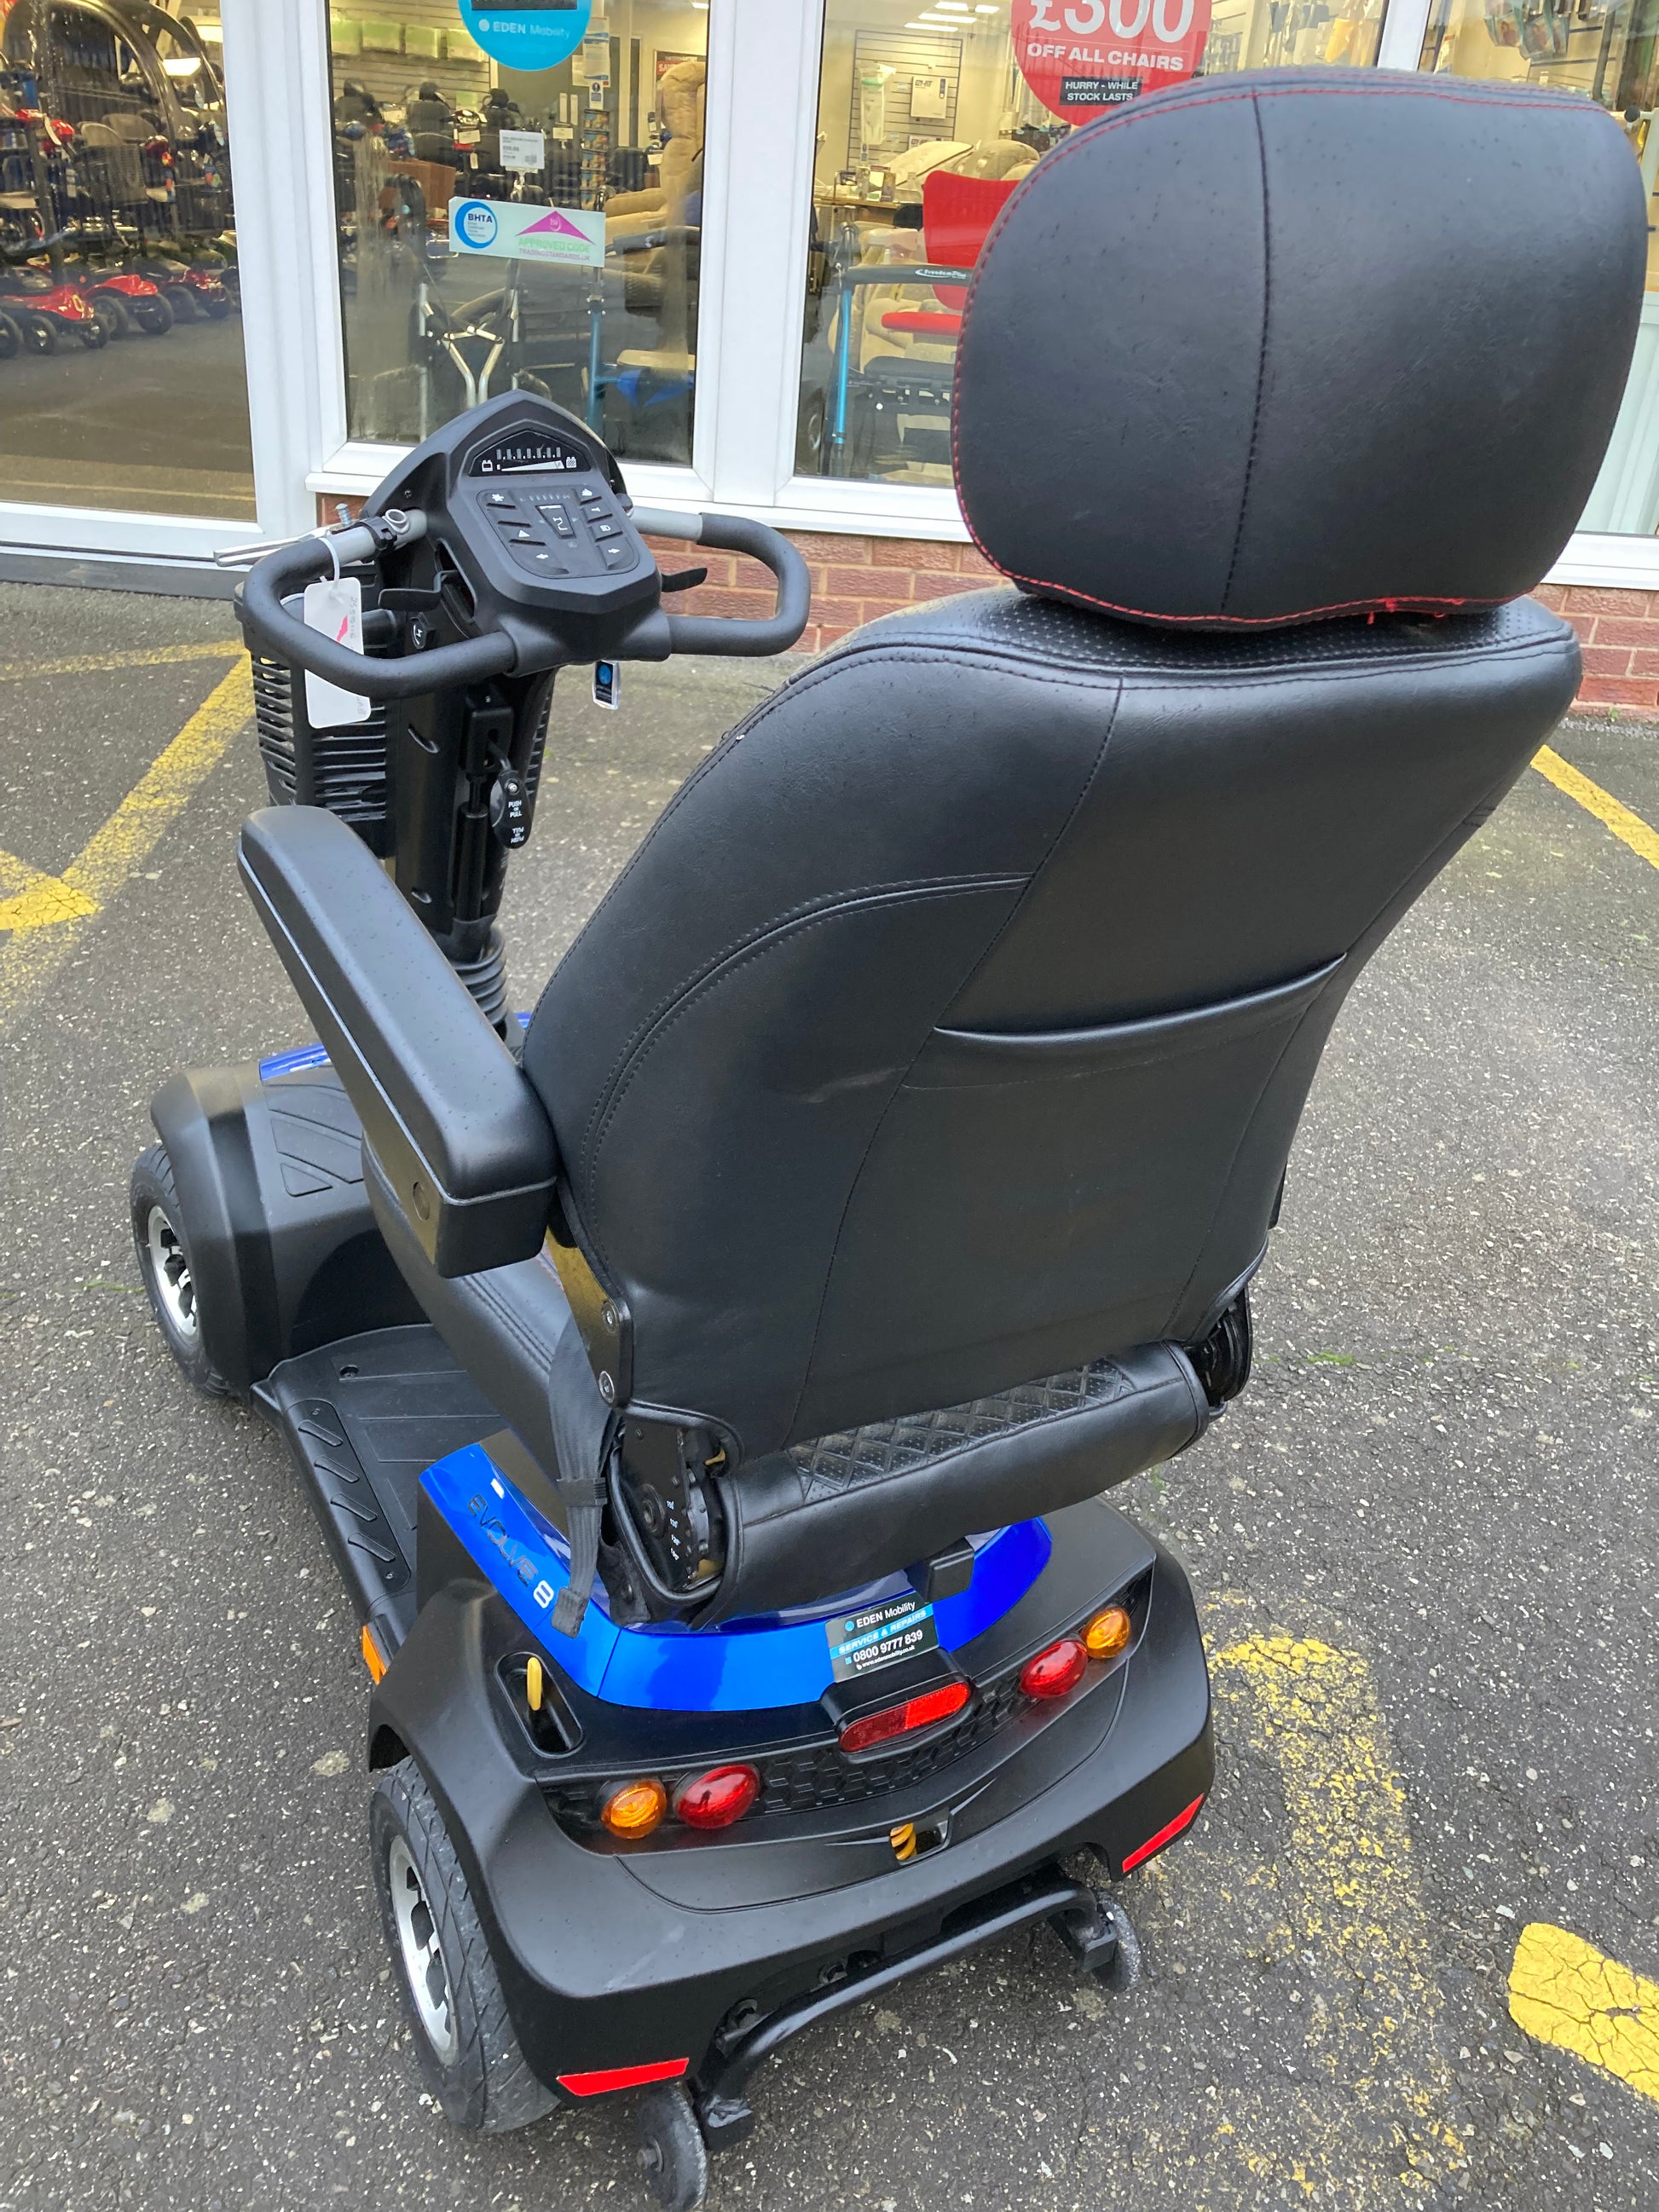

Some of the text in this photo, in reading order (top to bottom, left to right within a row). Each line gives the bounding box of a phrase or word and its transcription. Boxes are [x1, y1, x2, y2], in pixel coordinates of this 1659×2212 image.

[493, 21, 570, 39] EDEN Mobility
[1027, 43, 1184, 71] OFF ALL CHAIRS
[1066, 81, 1100, 90] HURRY
[1107, 81, 1138, 90] WHILE
[1067, 92, 1133, 101] STOCK LASTS
[468, 213, 493, 223] BHTA
[508, 800, 523, 808] PUSH
[468, 1494, 554, 1608] EVOLVE 8
[856, 1602, 916, 1628] EDEN Mobility
[838, 1609, 927, 1654] SERVICE & REPAIRS
[853, 1629, 923, 1663] 0800 9777 839
[861, 1644, 916, 1667] www.edenmobility.co.uk
